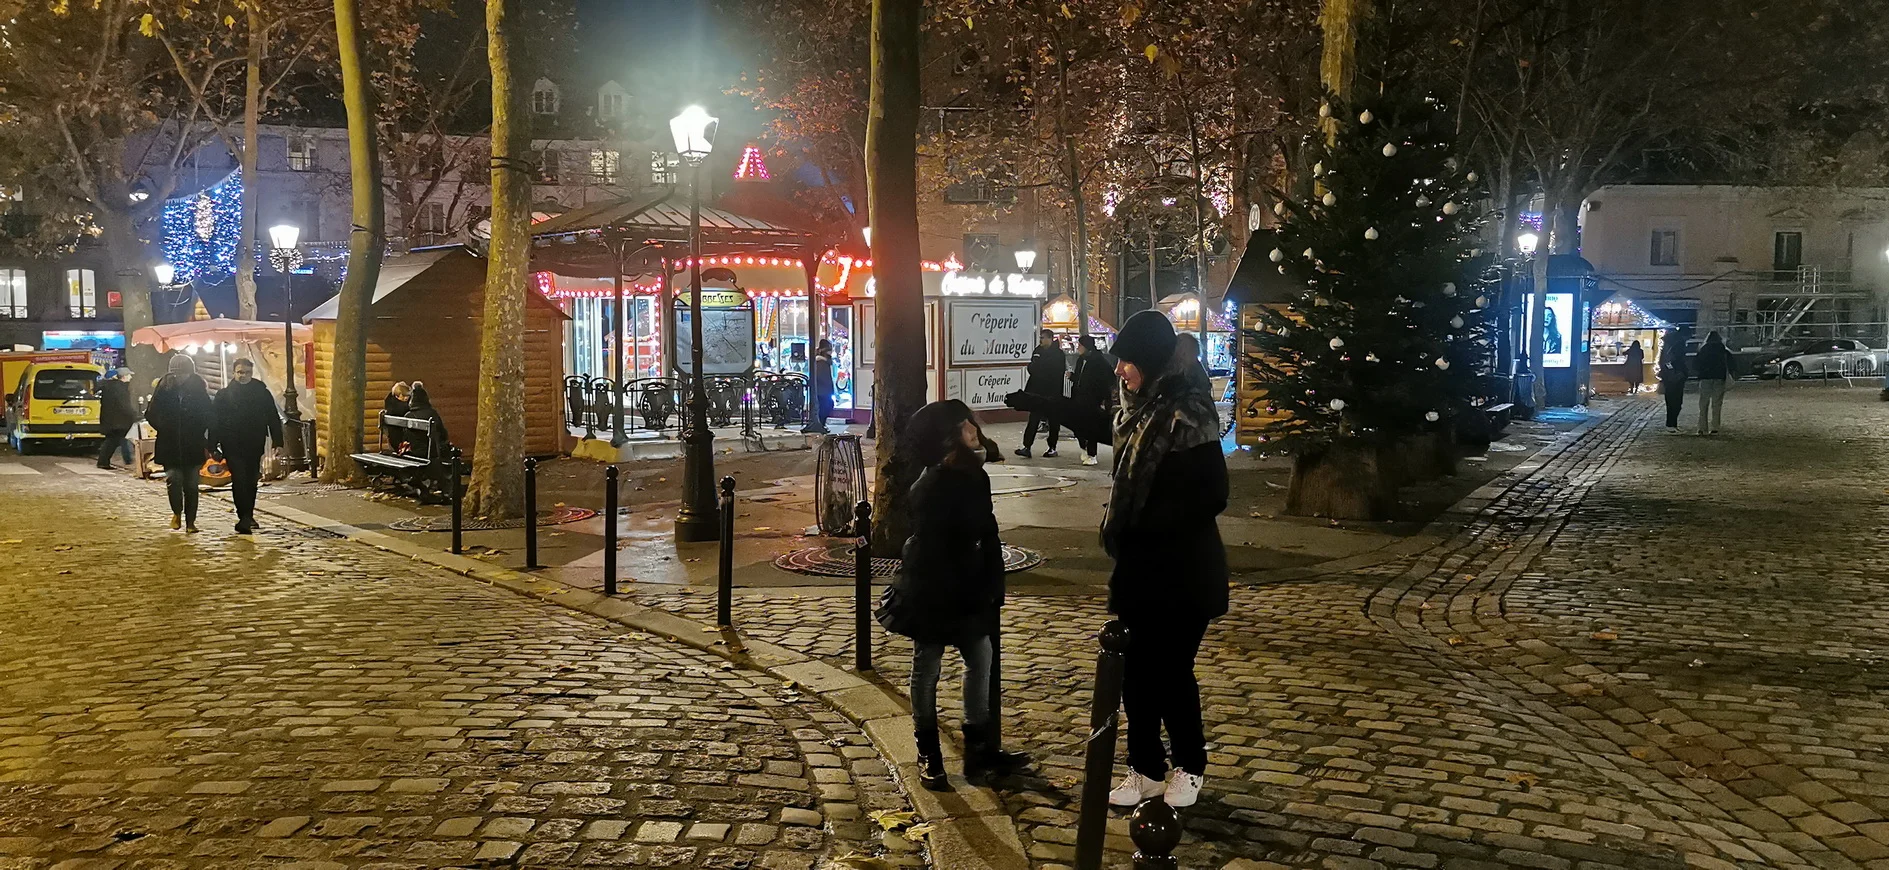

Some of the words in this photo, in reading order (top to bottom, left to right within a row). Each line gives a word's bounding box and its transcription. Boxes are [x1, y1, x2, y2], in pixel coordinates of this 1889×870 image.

[971, 312, 1019, 333] Crêperie
[960, 339, 975, 355] du
[982, 339, 1028, 359] Manège
[978, 374, 1011, 389] Crêperie
[971, 392, 982, 404] du
